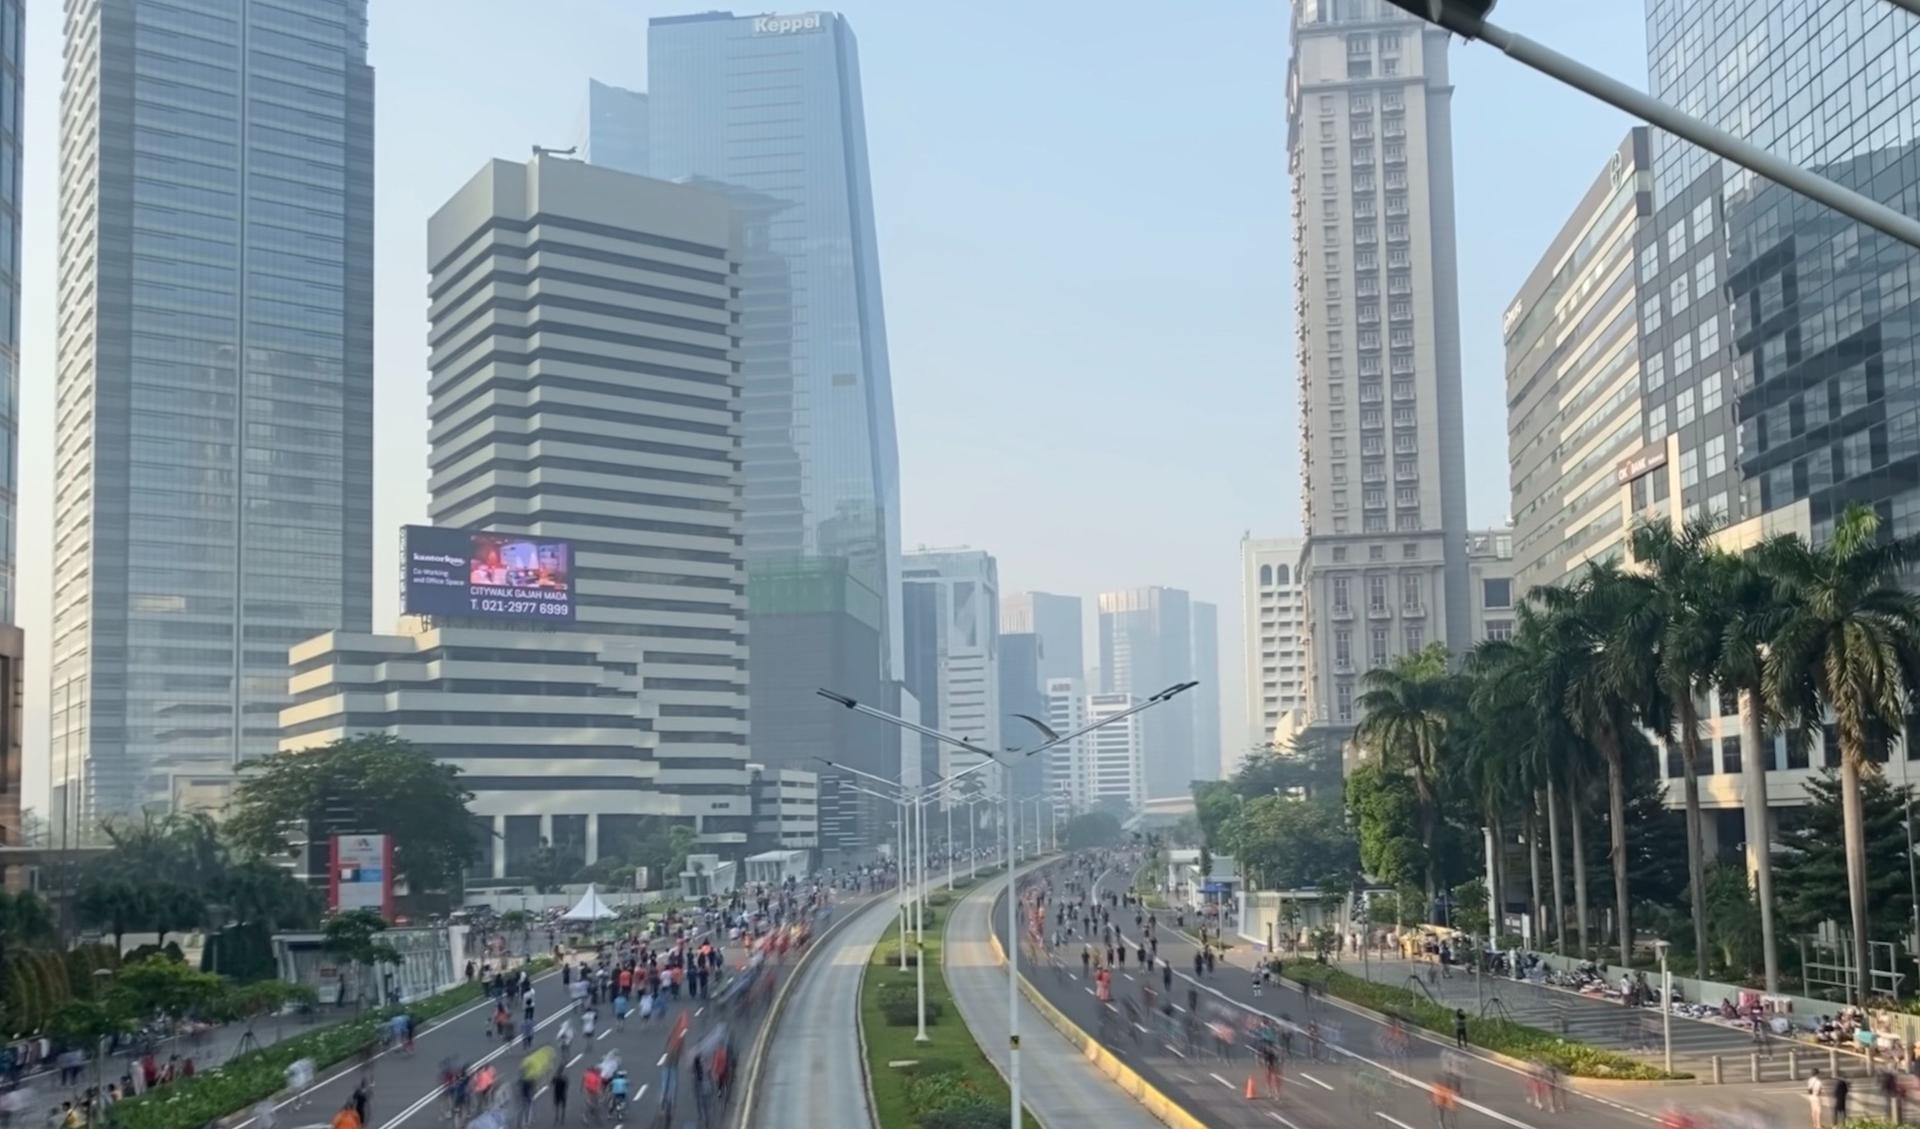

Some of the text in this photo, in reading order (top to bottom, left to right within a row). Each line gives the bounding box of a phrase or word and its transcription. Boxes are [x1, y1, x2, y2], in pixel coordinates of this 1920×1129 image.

[754, 14, 821, 34] Keppel
[426, 577, 444, 585] Office
[470, 586, 567, 601] CITYWALK GAJAH MADA
[481, 600, 536, 613] 021-2977
[539, 603, 568, 616] 6999
